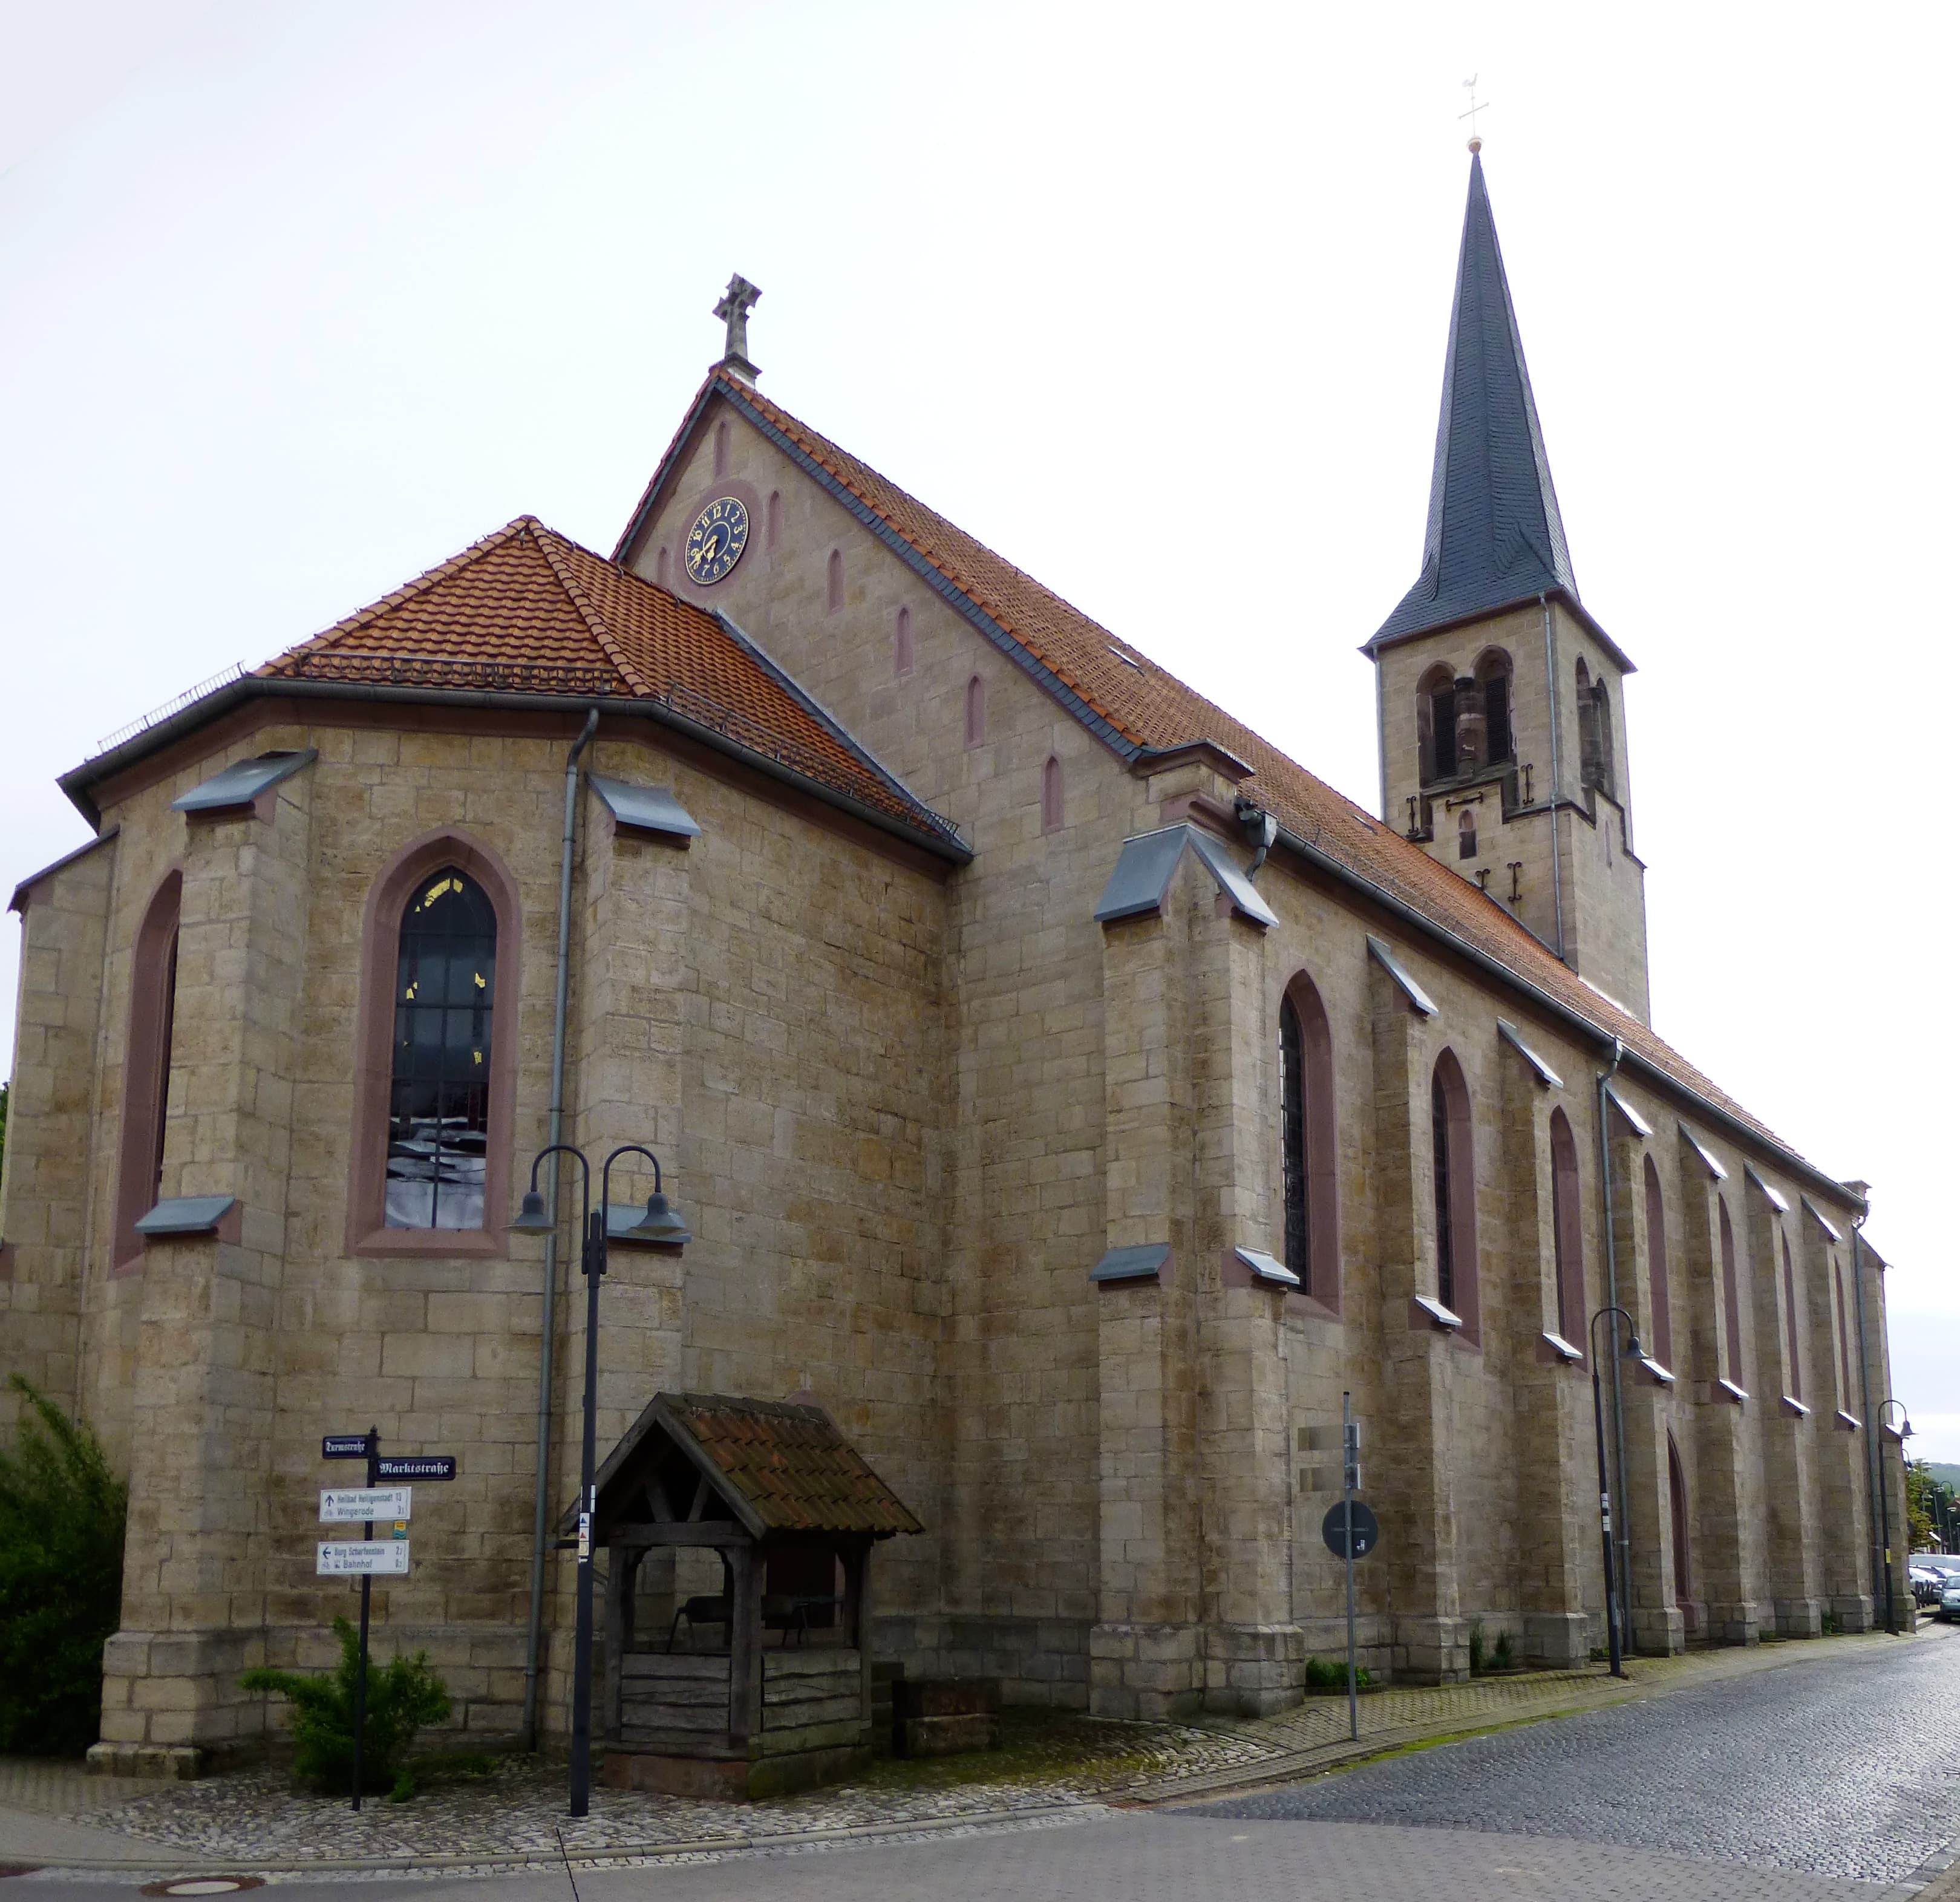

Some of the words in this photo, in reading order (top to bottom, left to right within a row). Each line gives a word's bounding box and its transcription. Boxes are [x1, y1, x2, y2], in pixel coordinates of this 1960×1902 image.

[713, 505, 722, 520] 12
[724, 504, 731, 517] 1
[701, 515, 710, 528] 11
[731, 511, 740, 523] 2
[693, 530, 702, 541] 10
[734, 525, 743, 534] 3
[731, 542, 742, 551] 4
[724, 554, 731, 566] 5
[702, 564, 710, 576] 7
[713, 562, 719, 574] 6
[325, 1441, 365, 1453] Turmstraße
[379, 1462, 449, 1474] Marktstraße
[337, 1506, 374, 1518] Wingerode
[343, 1558, 373, 1569] Bahnhof
